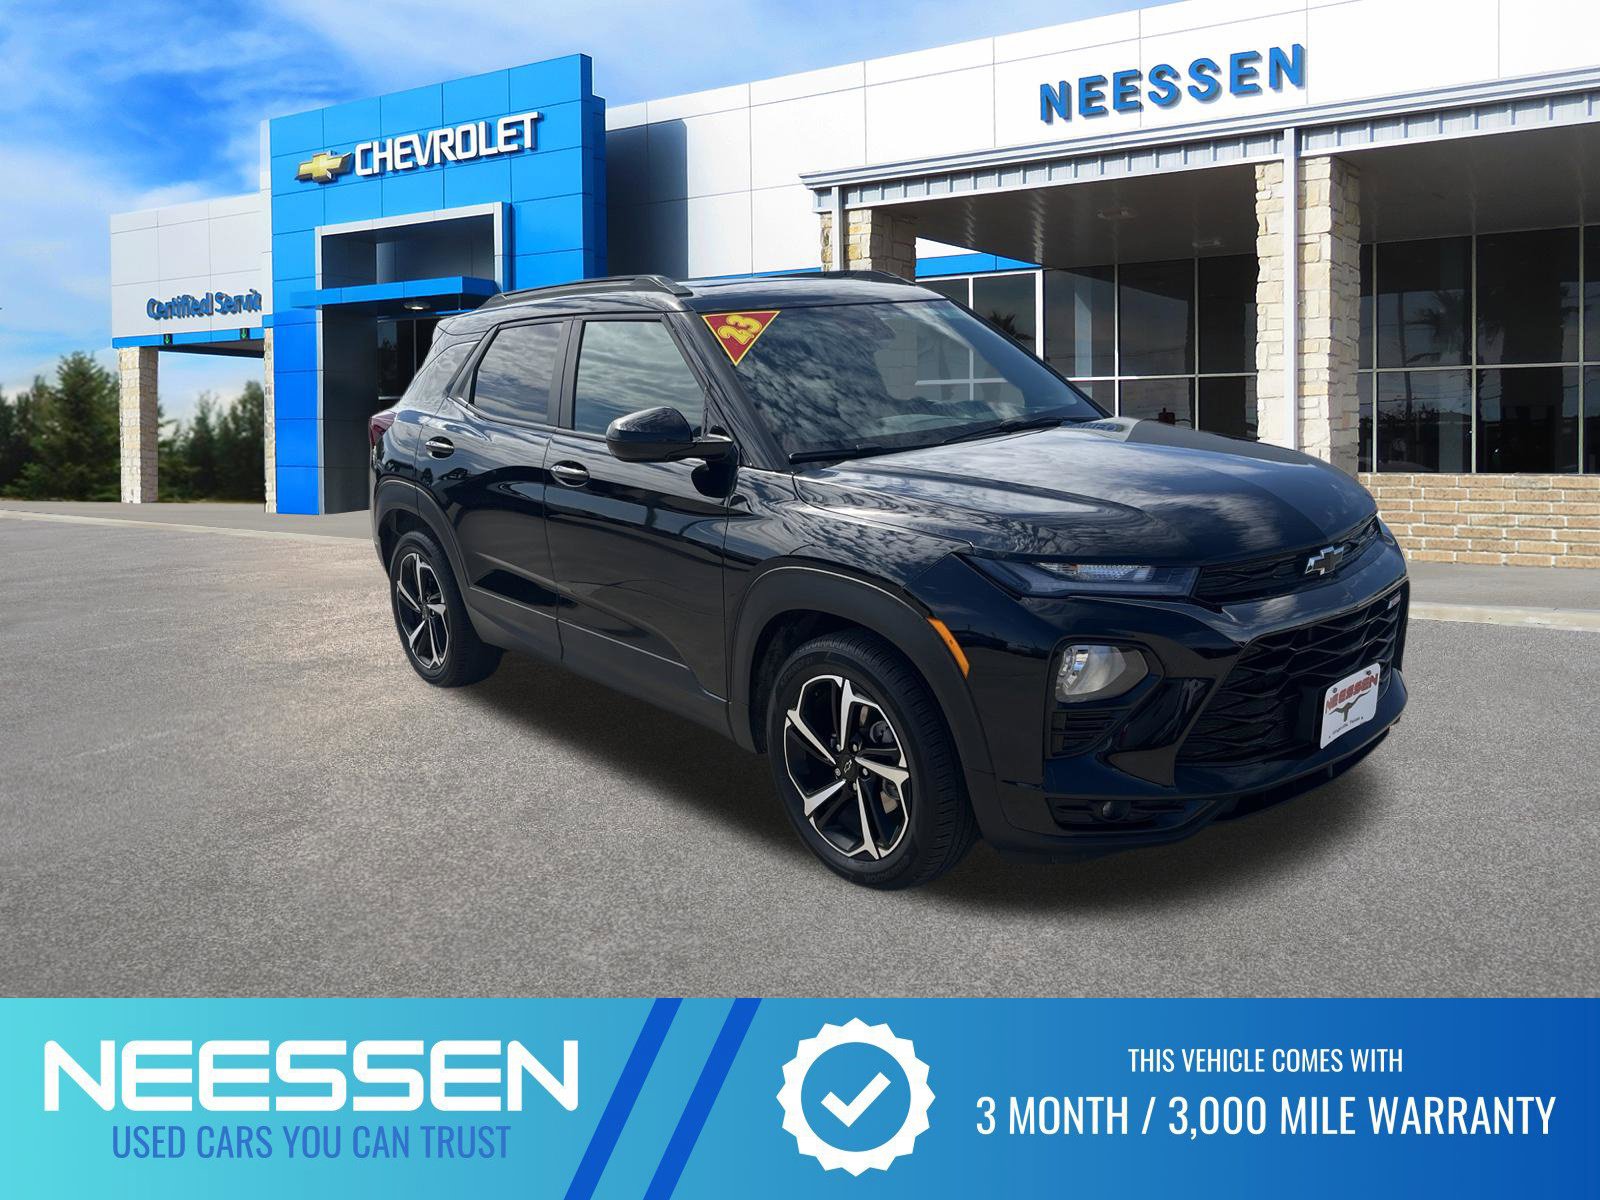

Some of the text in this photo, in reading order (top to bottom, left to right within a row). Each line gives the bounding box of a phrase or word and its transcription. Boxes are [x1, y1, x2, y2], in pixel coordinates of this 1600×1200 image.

[1040, 44, 1306, 124] NEESSEN
[354, 111, 541, 177] CHEVROLET
[146, 292, 213, 320] Certified
[718, 314, 763, 345] 23
